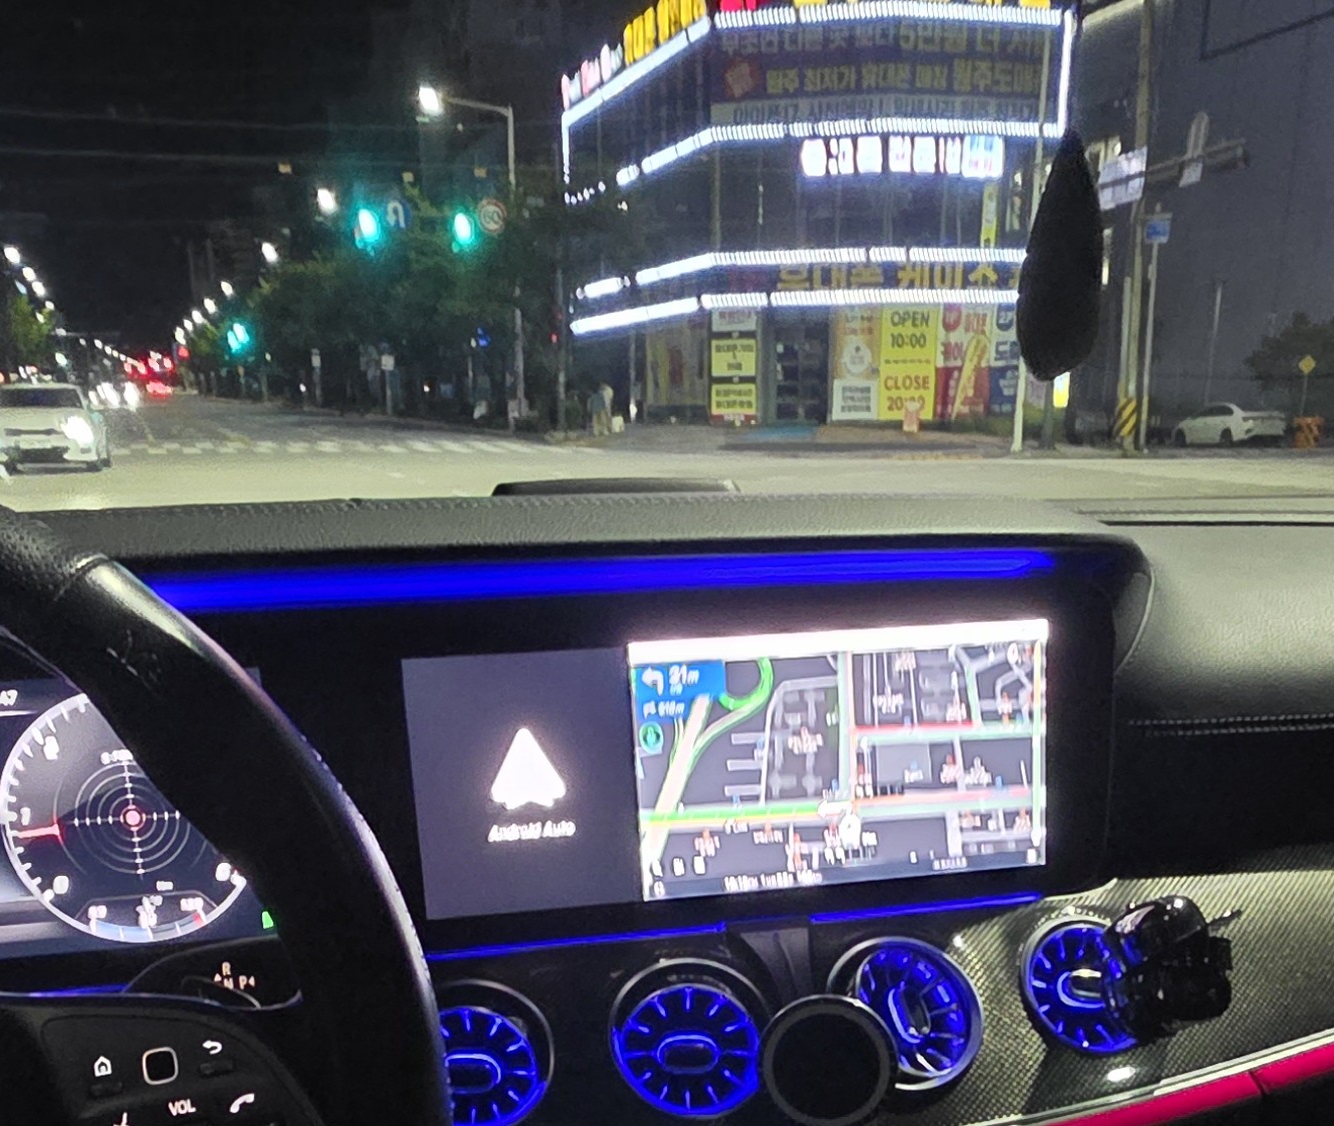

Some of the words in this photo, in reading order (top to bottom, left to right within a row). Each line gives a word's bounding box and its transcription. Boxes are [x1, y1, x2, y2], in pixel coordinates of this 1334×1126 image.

[890, 311, 930, 328] OPEN
[890, 333, 927, 349] 10:00
[884, 375, 930, 391] CLOSE
[487, 821, 542, 842] Android
[542, 820, 576, 838] Auto
[222, 961, 232, 976] R
[239, 975, 247, 990] P
[168, 1099, 196, 1116] VOL
